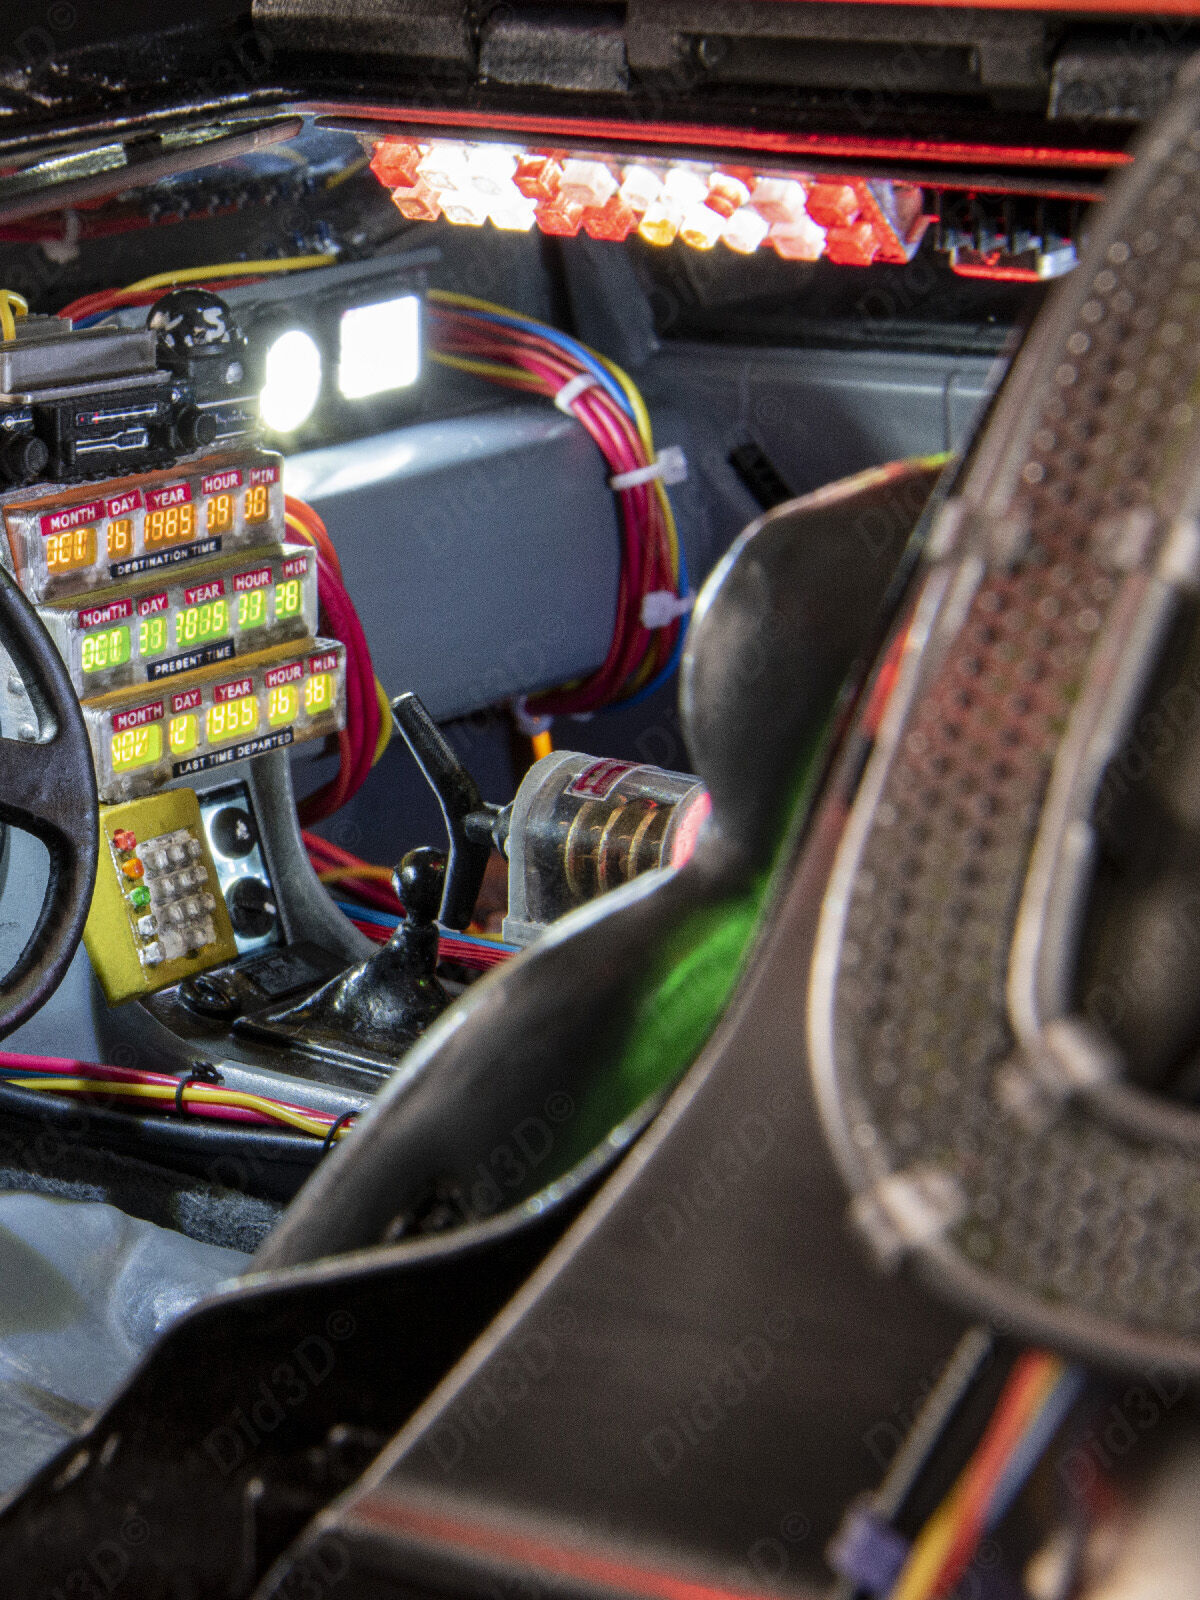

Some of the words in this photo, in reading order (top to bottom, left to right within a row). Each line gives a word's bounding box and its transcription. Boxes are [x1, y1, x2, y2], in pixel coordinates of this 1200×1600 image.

[50, 507, 96, 529] MONTH
[111, 495, 136, 516] DAY
[153, 488, 186, 506] YEAR
[204, 473, 239, 492] HOUR
[251, 467, 275, 483] MIN
[117, 550, 188, 575] DESTINATION
[192, 542, 217, 557] TIME
[82, 602, 128, 626] MONTH
[141, 597, 166, 617] DAY
[188, 583, 220, 602] YEAR
[235, 571, 270, 590] HOUR
[285, 559, 307, 577] MIN
[154, 656, 202, 676] PRESENT
[206, 645, 232, 661] TIME
[118, 703, 163, 729] MONTH
[174, 692, 199, 711] DAY
[220, 681, 251, 700] YEAR
[268, 666, 302, 687] HOUR
[313, 656, 337, 672] MIN
[179, 758, 206, 774] LAST
[209, 750, 234, 765] TIME
[237, 734, 292, 758] DEPARTED
